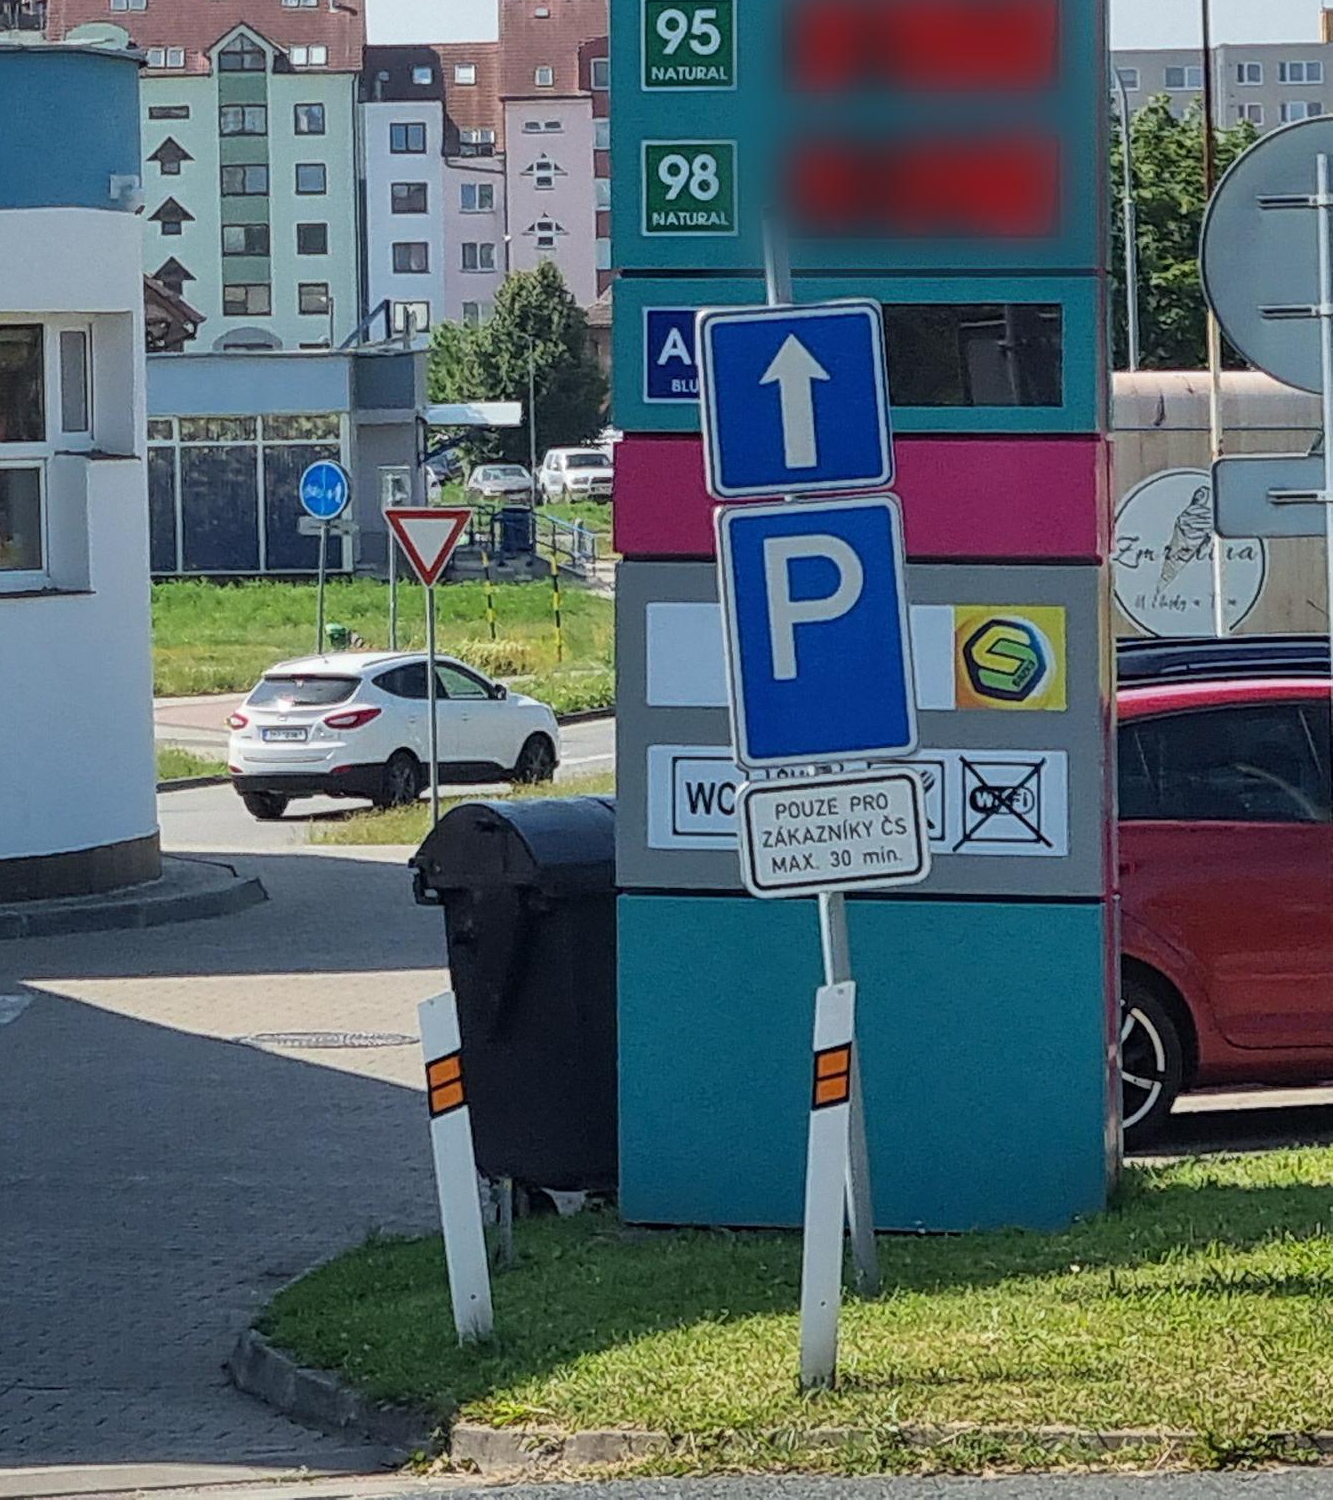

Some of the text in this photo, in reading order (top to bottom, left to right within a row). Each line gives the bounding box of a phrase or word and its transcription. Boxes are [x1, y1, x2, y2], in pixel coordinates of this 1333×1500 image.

[655, 9, 722, 56] 95
[651, 65, 728, 82] NATURAL
[658, 153, 720, 201] 98
[652, 211, 729, 227] NATURAL
[656, 327, 693, 366] A
[671, 379, 699, 393] BLU
[763, 533, 865, 681] P
[685, 781, 736, 815] WC
[775, 792, 889, 820] POUZE PRO
[762, 815, 908, 848] ZÁKAZNÍKY ČS
[771, 846, 903, 874] MAX. 30 min.
